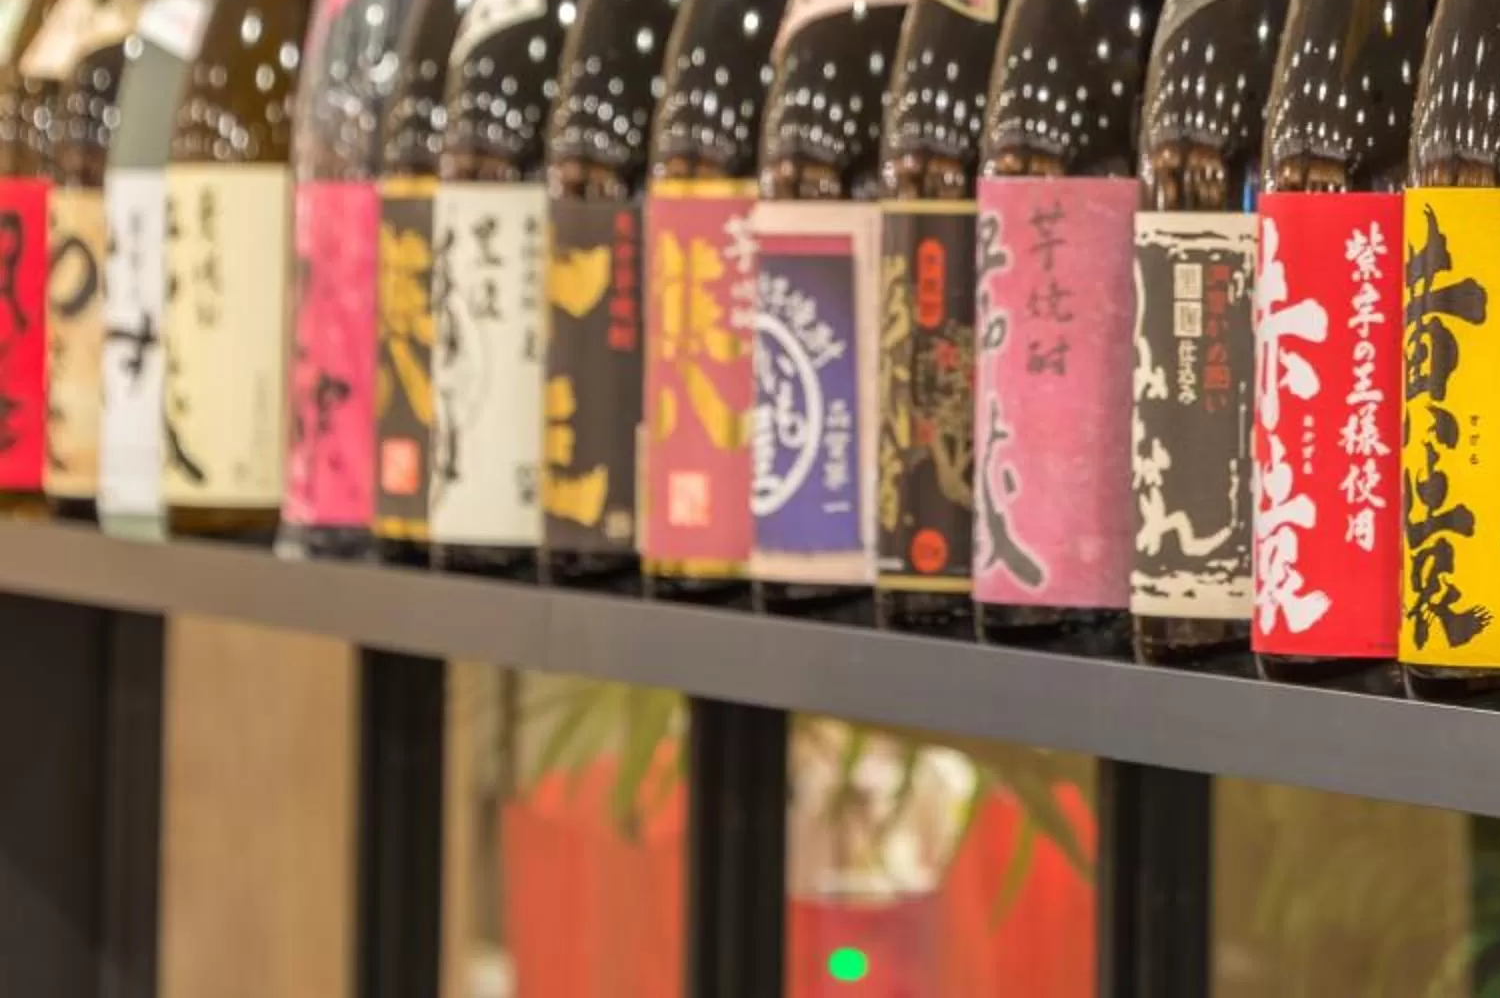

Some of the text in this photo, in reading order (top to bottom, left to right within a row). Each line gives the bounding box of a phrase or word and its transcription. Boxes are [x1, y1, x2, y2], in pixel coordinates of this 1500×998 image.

[1024, 207, 1077, 378] 芋焼酎
[1337, 221, 1391, 552] 紫芋の王様使用
